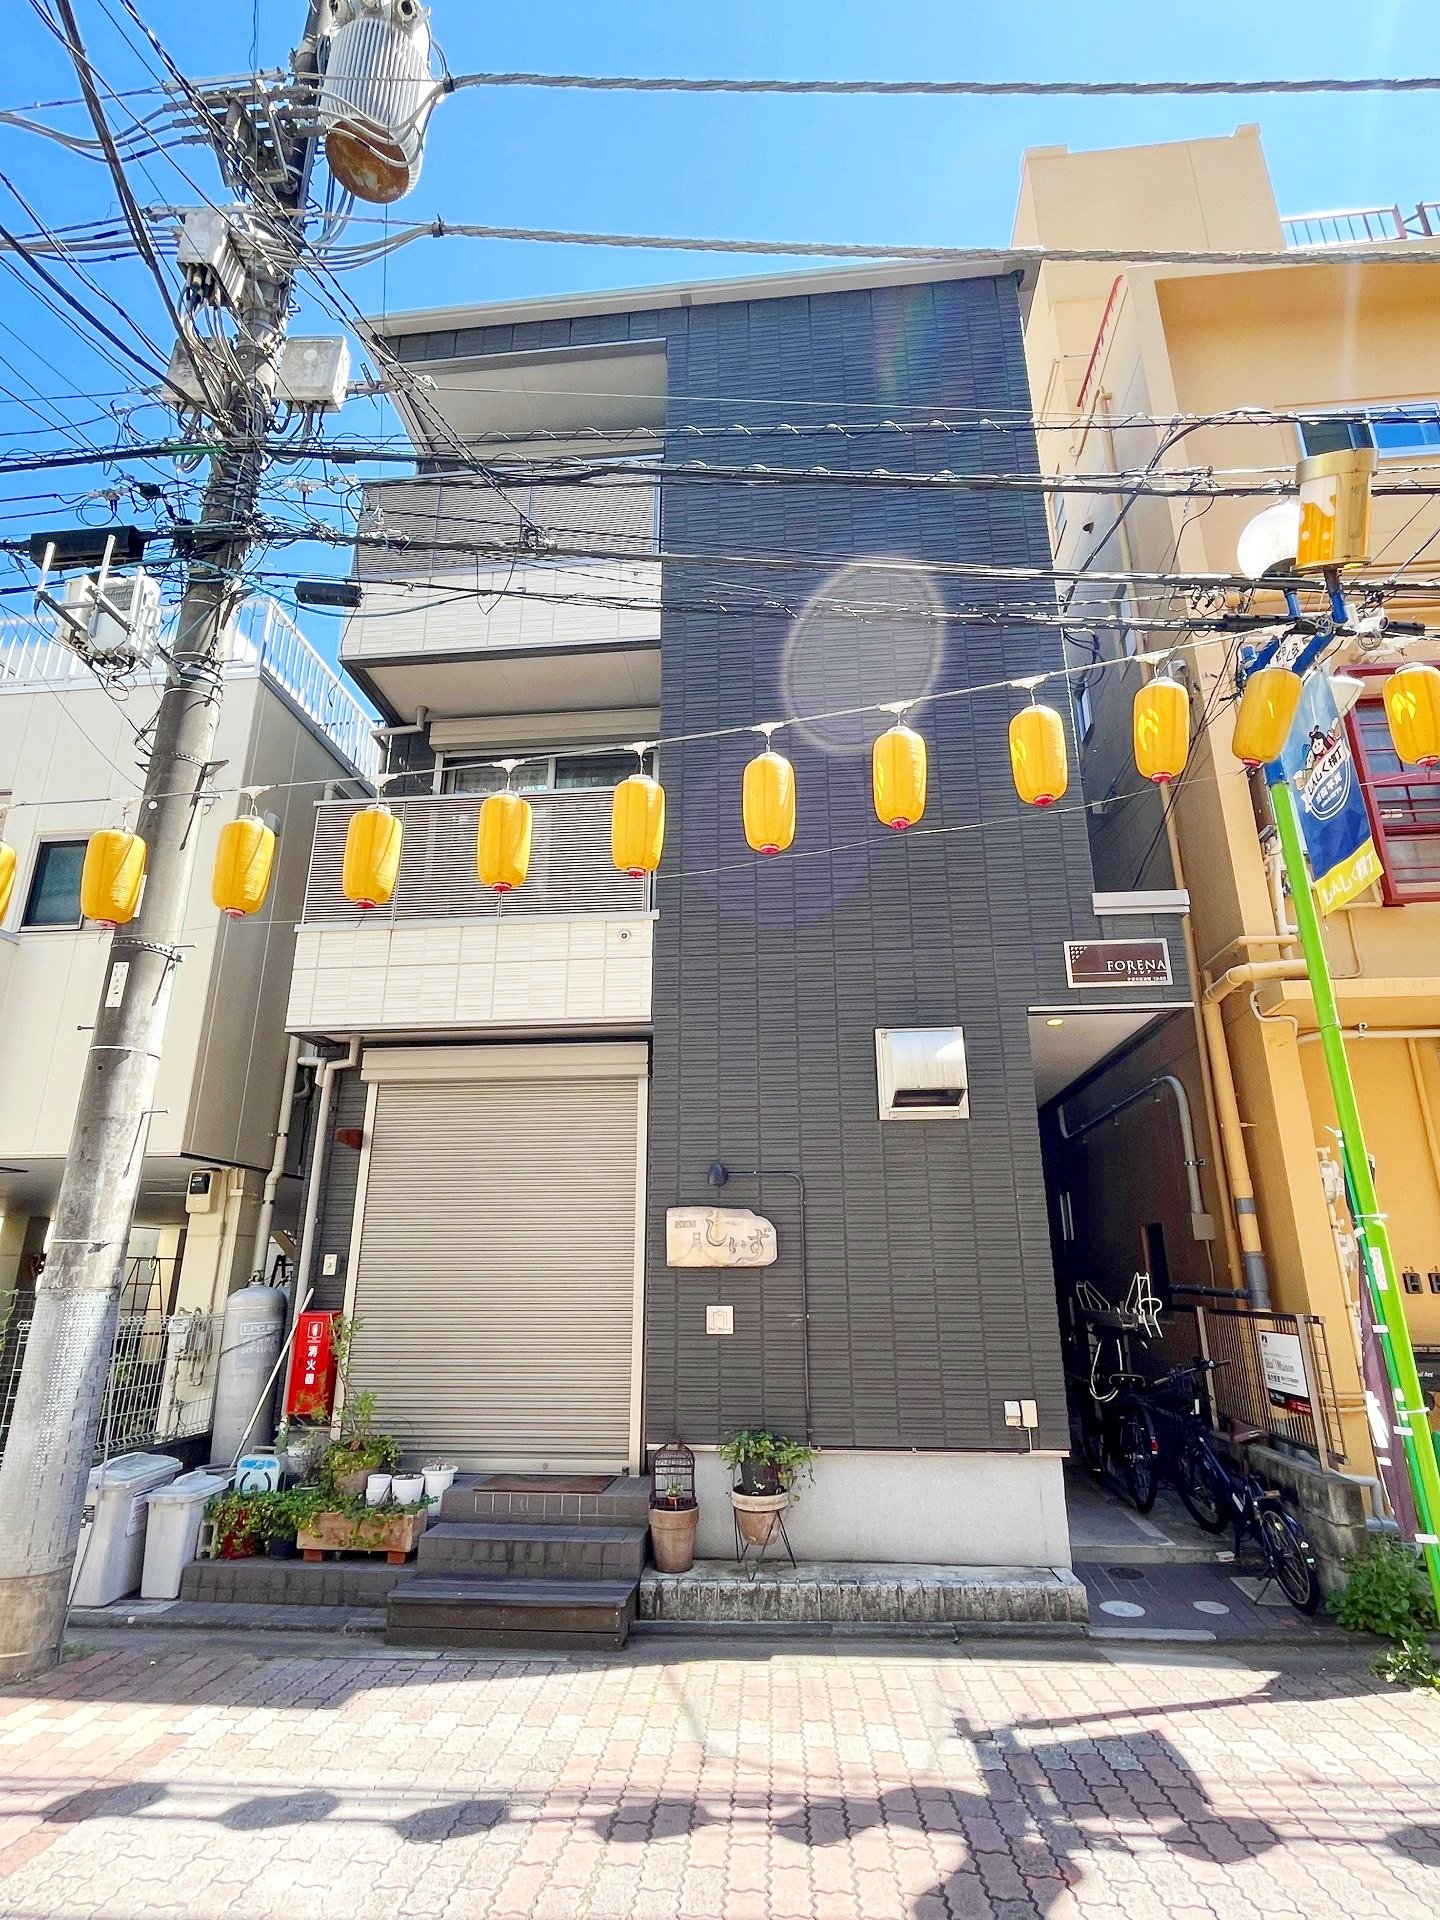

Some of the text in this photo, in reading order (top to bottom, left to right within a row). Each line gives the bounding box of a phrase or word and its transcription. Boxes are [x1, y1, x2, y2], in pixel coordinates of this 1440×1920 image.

[1106, 959, 1166, 971] FORENA
[304, 1345, 318, 1385] 消火器
